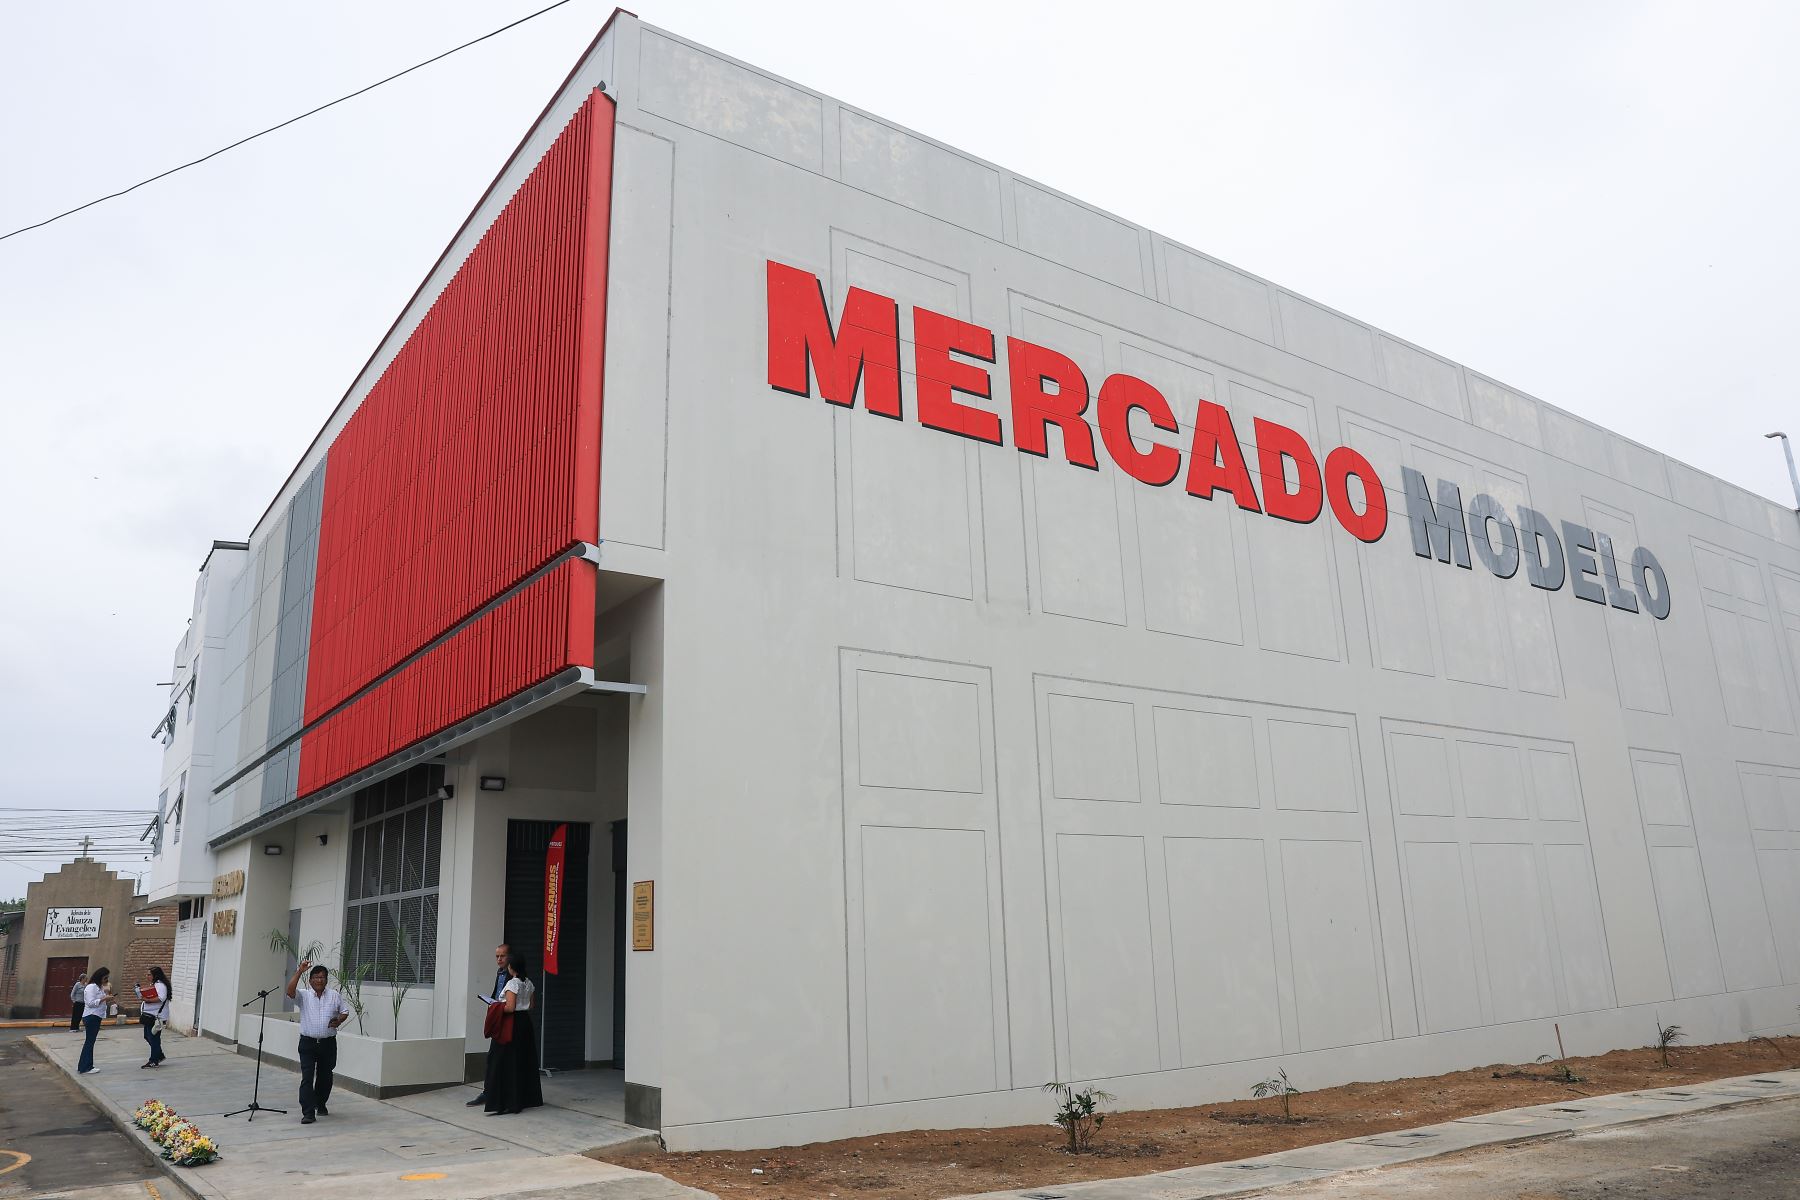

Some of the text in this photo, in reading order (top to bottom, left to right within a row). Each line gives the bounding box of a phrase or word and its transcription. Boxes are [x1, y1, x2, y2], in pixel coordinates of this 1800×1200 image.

[767, 259, 1671, 620] MERCADO MODELO
[67, 916, 93, 925] Alianza
[546, 864, 557, 952] IMPULSAMOS
